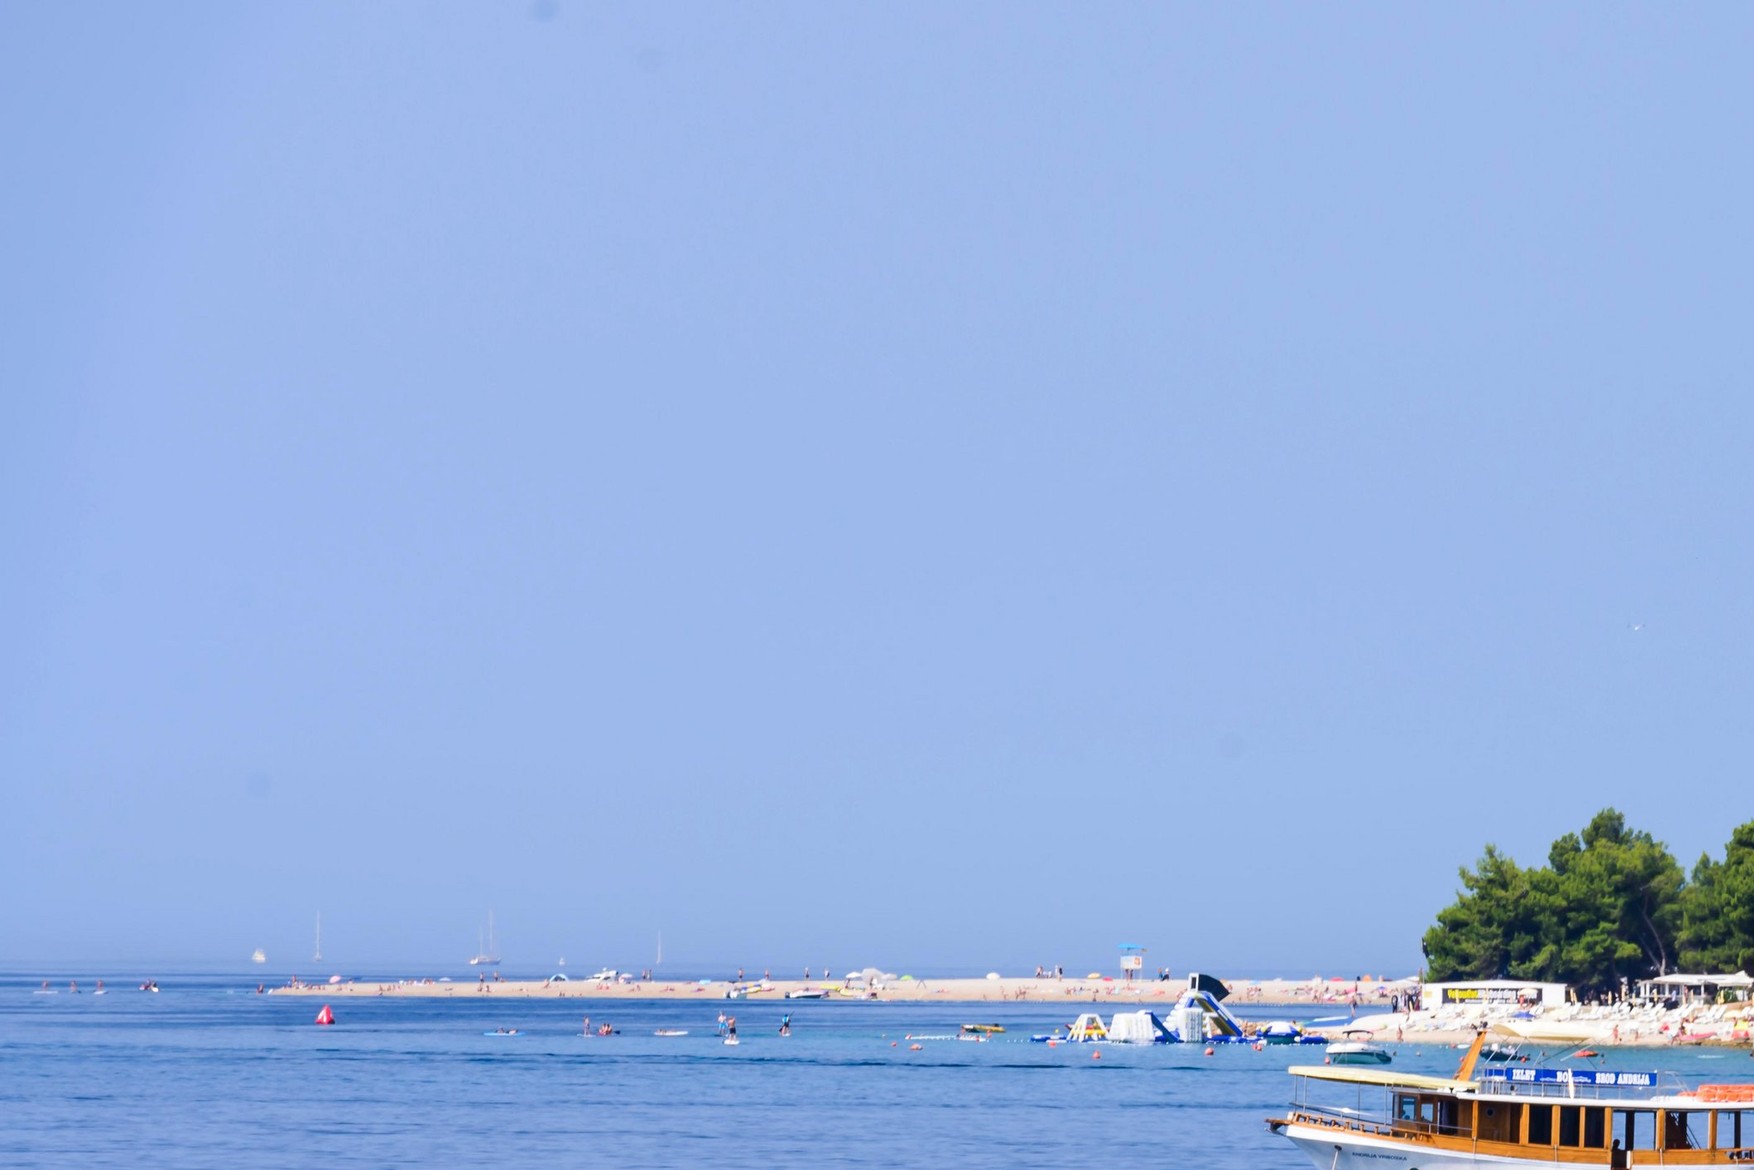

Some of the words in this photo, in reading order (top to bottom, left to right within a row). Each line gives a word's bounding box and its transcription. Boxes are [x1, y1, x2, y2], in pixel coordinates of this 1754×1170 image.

[1556, 1070, 1572, 1083] BO
[1595, 1071, 1616, 1084] BROD
[1617, 1073, 1650, 1085] ANDRIJA
